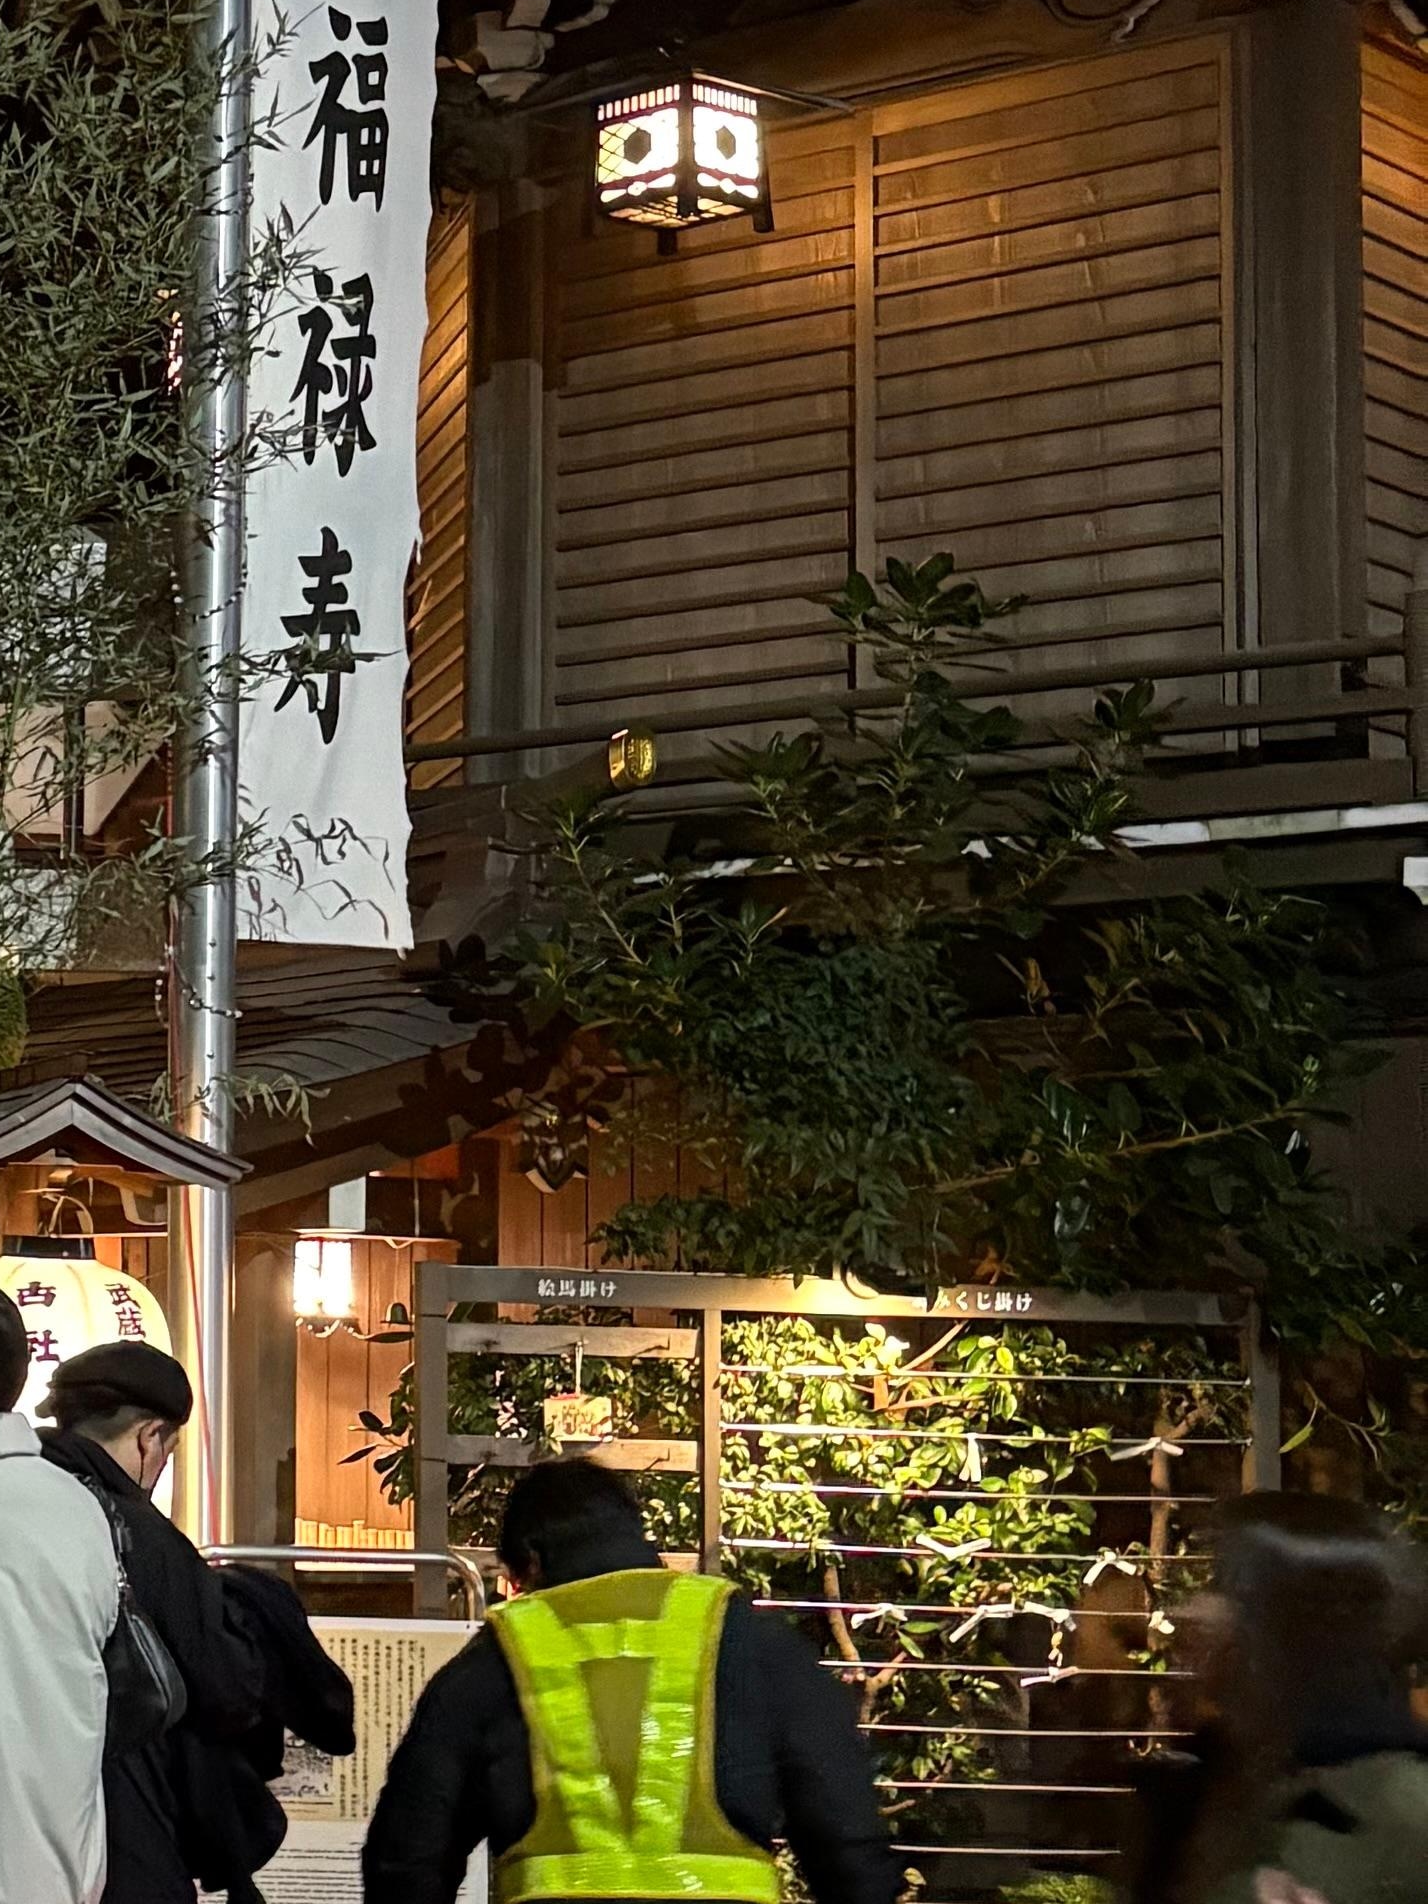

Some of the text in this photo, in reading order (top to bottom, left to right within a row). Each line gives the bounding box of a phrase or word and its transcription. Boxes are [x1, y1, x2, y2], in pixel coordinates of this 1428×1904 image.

[273, 6, 390, 745] 福禄寿
[538, 1279, 617, 1298] 絵馬掛け
